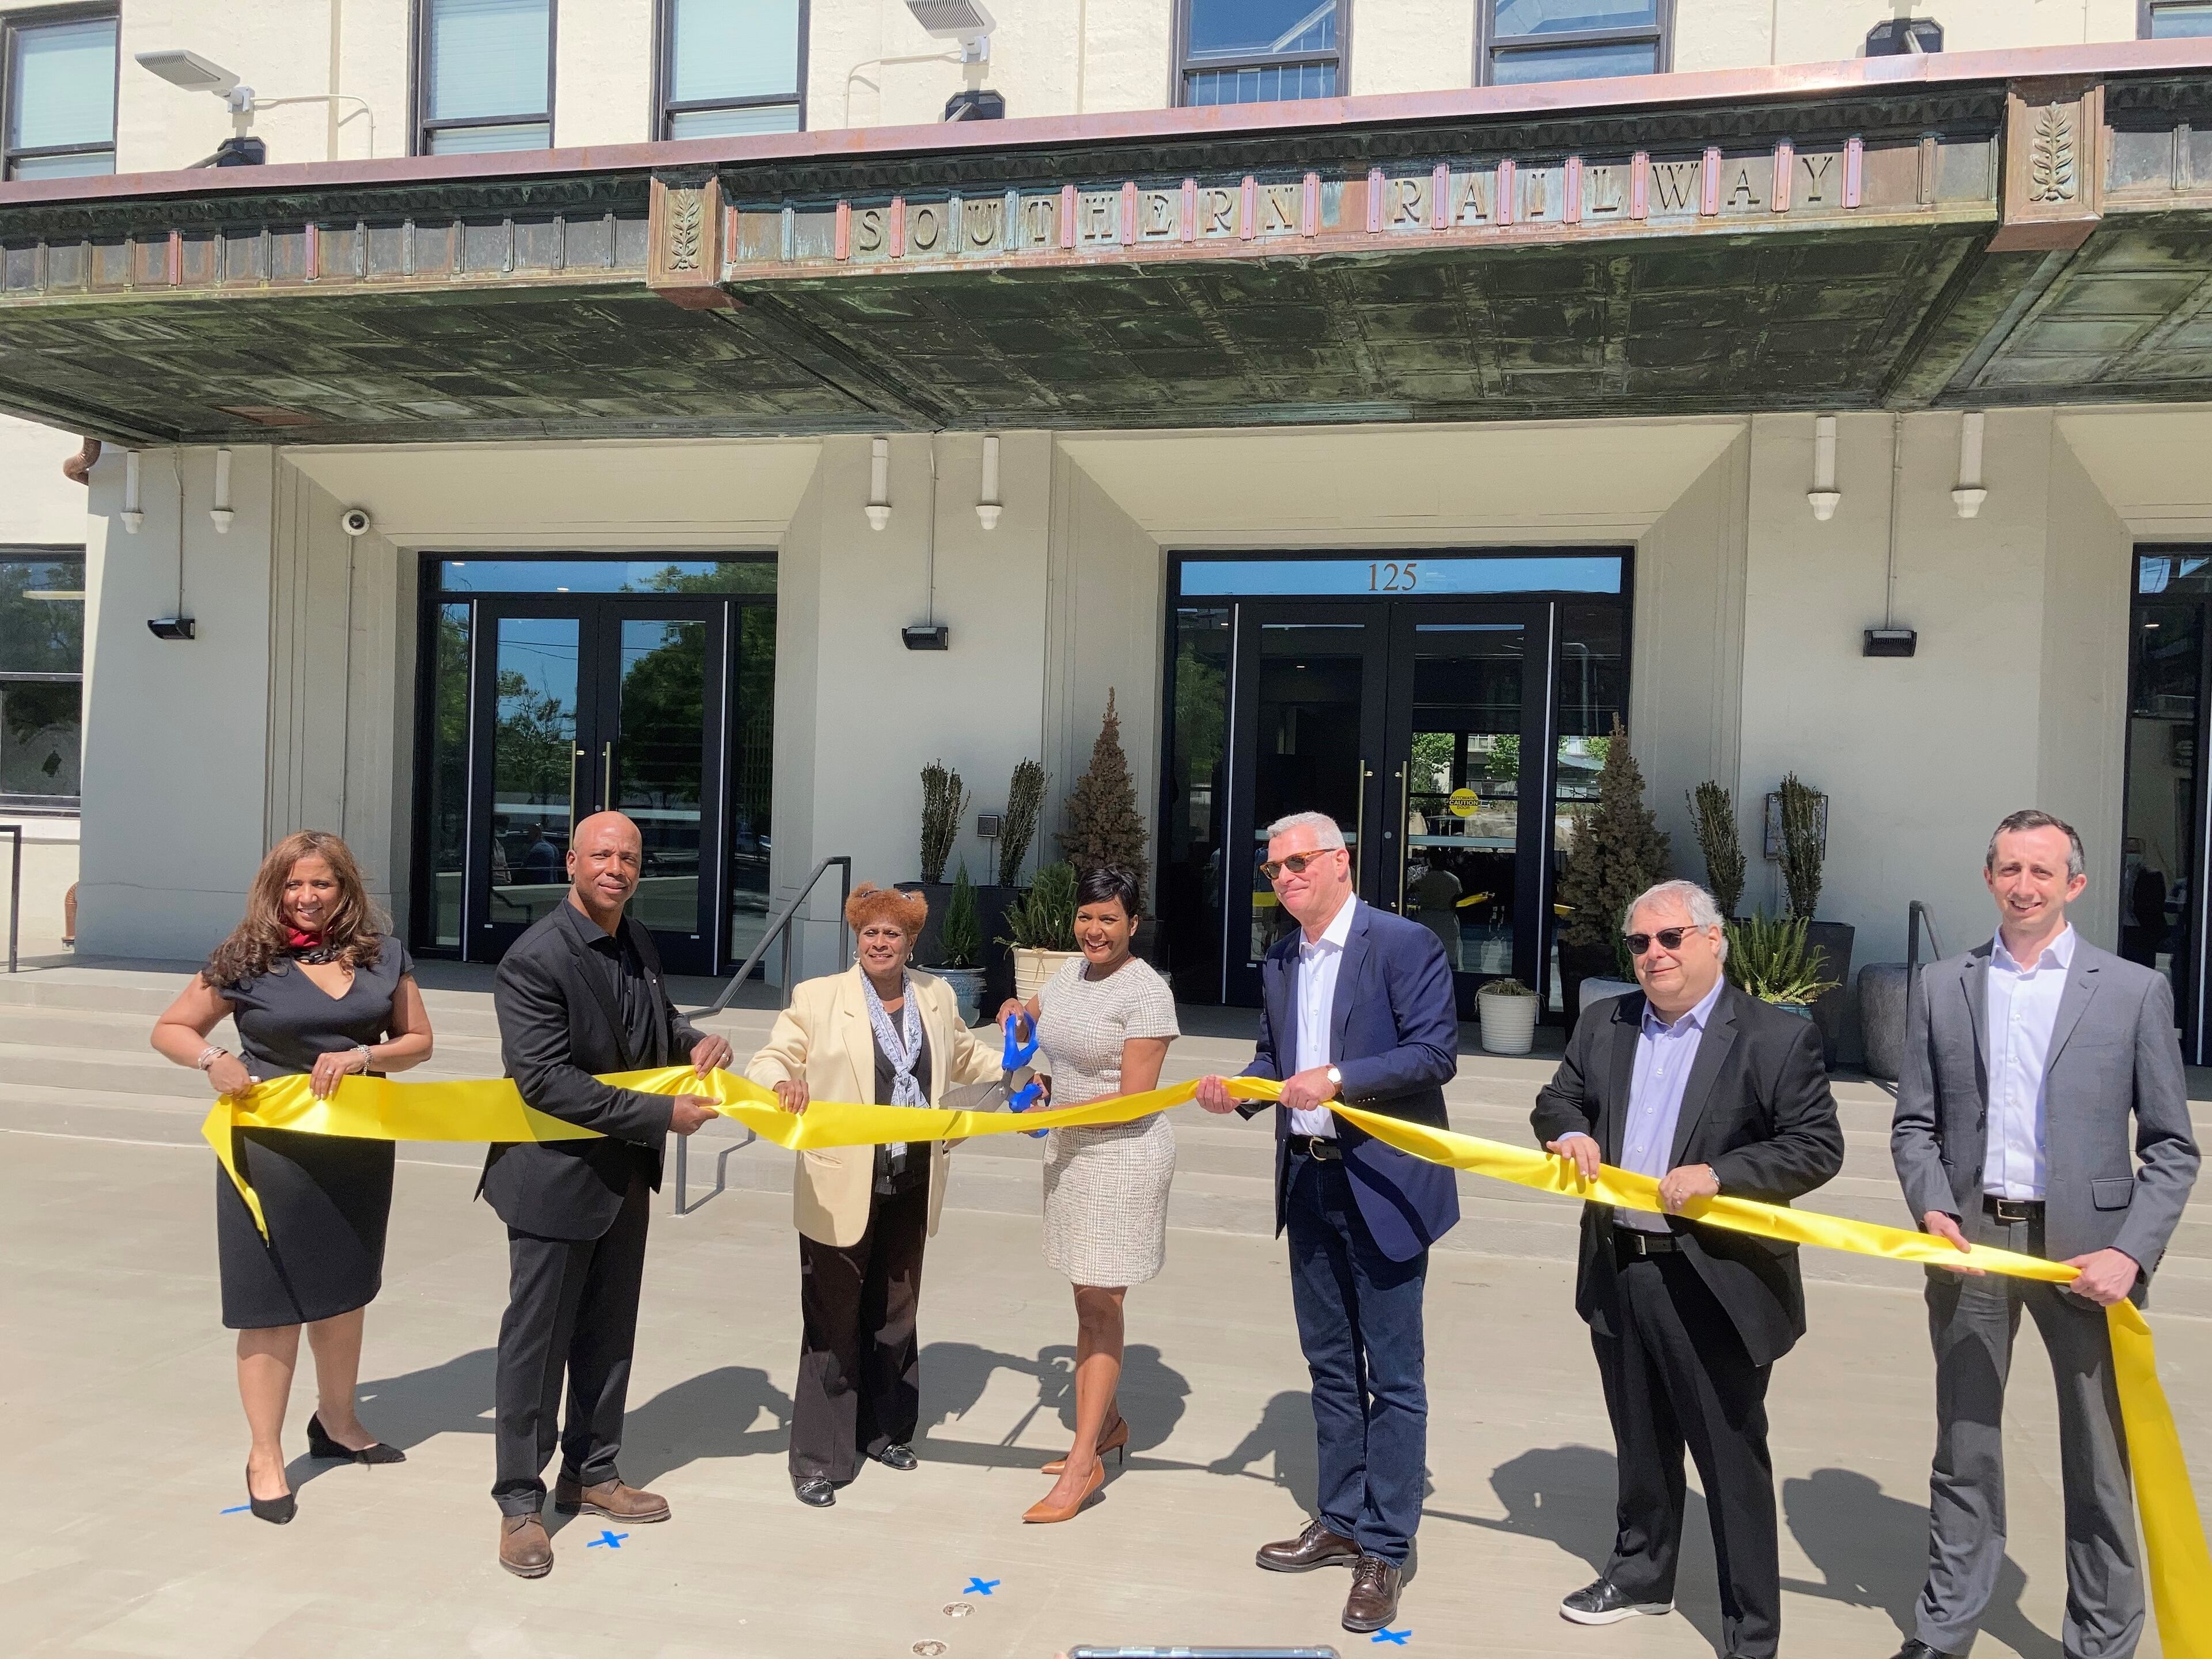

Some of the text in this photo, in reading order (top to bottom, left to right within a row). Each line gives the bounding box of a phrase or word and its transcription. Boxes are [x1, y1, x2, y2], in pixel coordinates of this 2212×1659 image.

[859, 155, 1833, 252] SOUTHERN RAILWAY
[1369, 563, 1417, 591] 125
